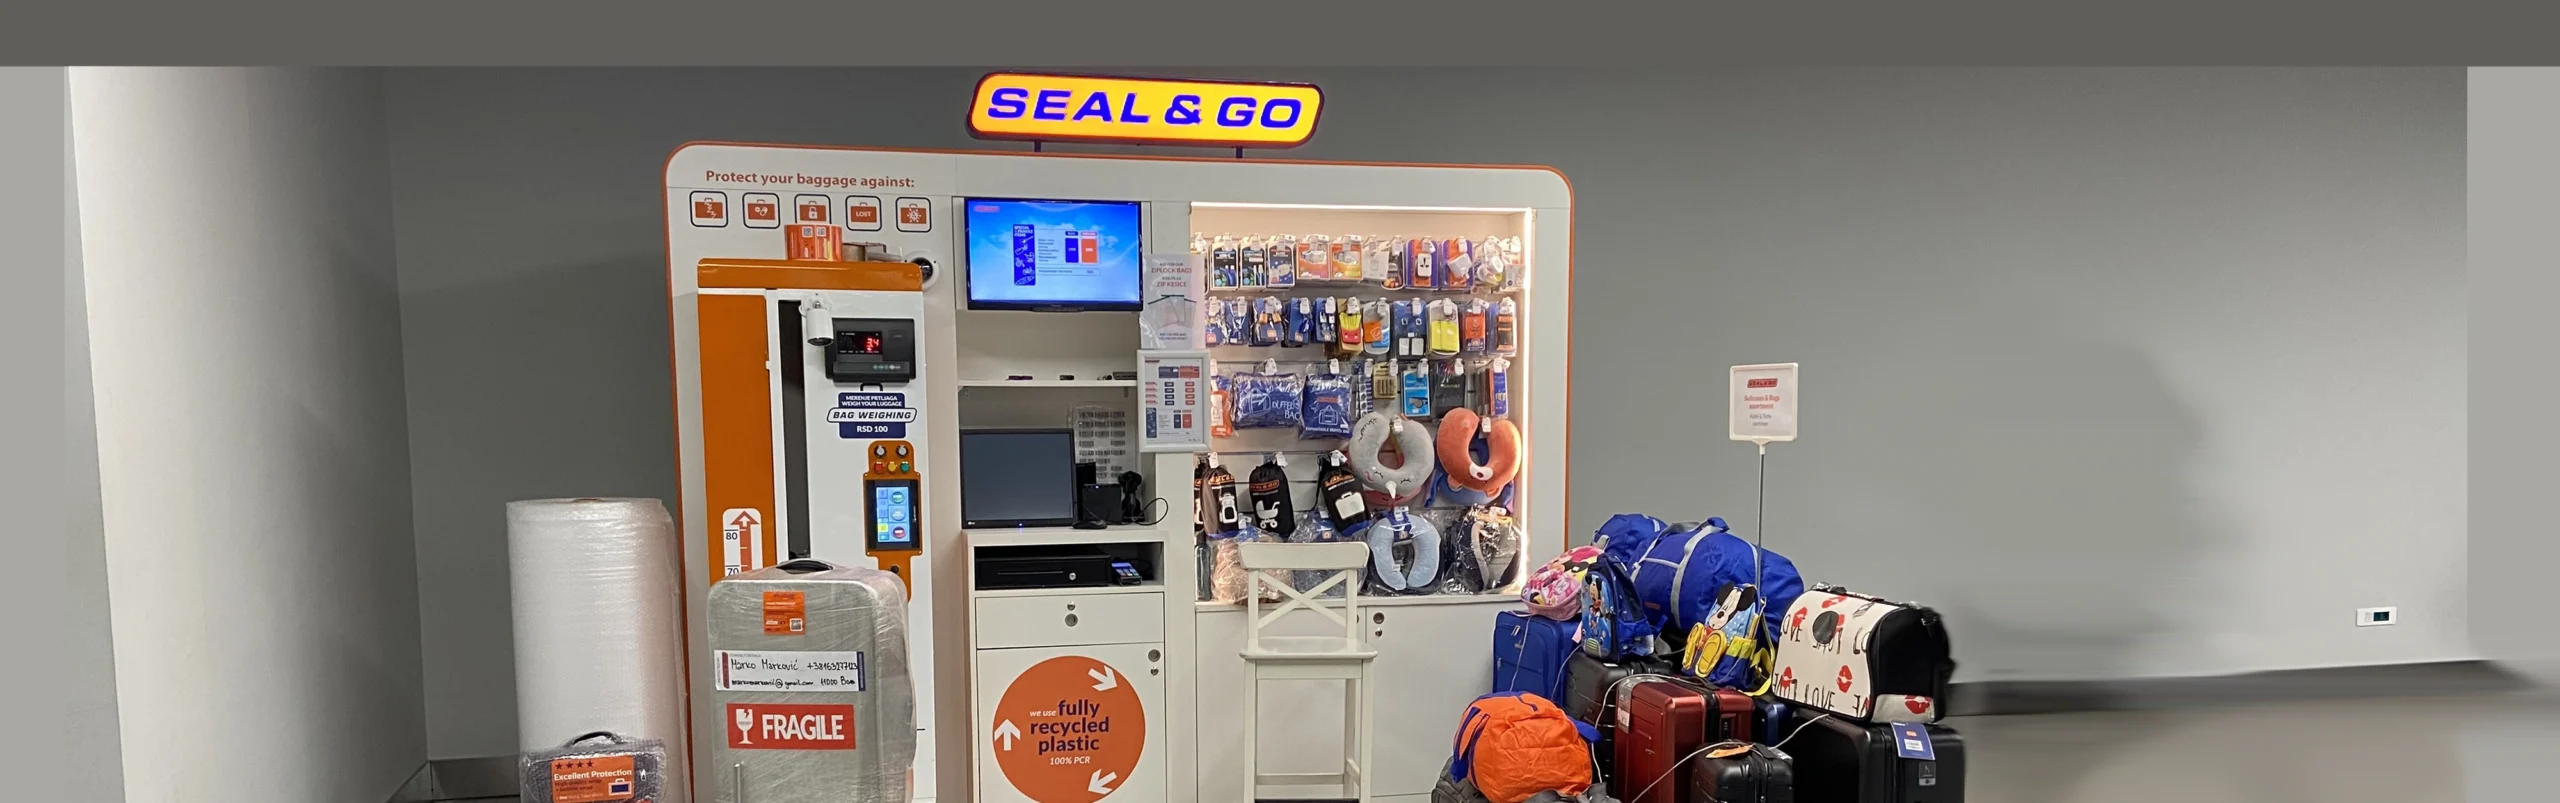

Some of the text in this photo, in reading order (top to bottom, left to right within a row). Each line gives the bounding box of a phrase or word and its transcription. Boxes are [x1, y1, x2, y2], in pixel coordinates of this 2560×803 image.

[987, 87, 1302, 128] SEAL & GO
[706, 170, 915, 188] Protect your baggage against:
[833, 411, 912, 419] BAG WEIGHING
[856, 425, 889, 433] RSD 100
[725, 532, 738, 540] 80
[731, 659, 756, 670] Marko
[762, 659, 799, 671] Marković
[1058, 699, 1101, 718] fully
[761, 714, 845, 741] FRAGILE
[1030, 716, 1110, 737] recycled
[1038, 735, 1100, 756] plastic
[1049, 756, 1091, 765] 100% PCR
[553, 769, 632, 781] Excellent Protection
